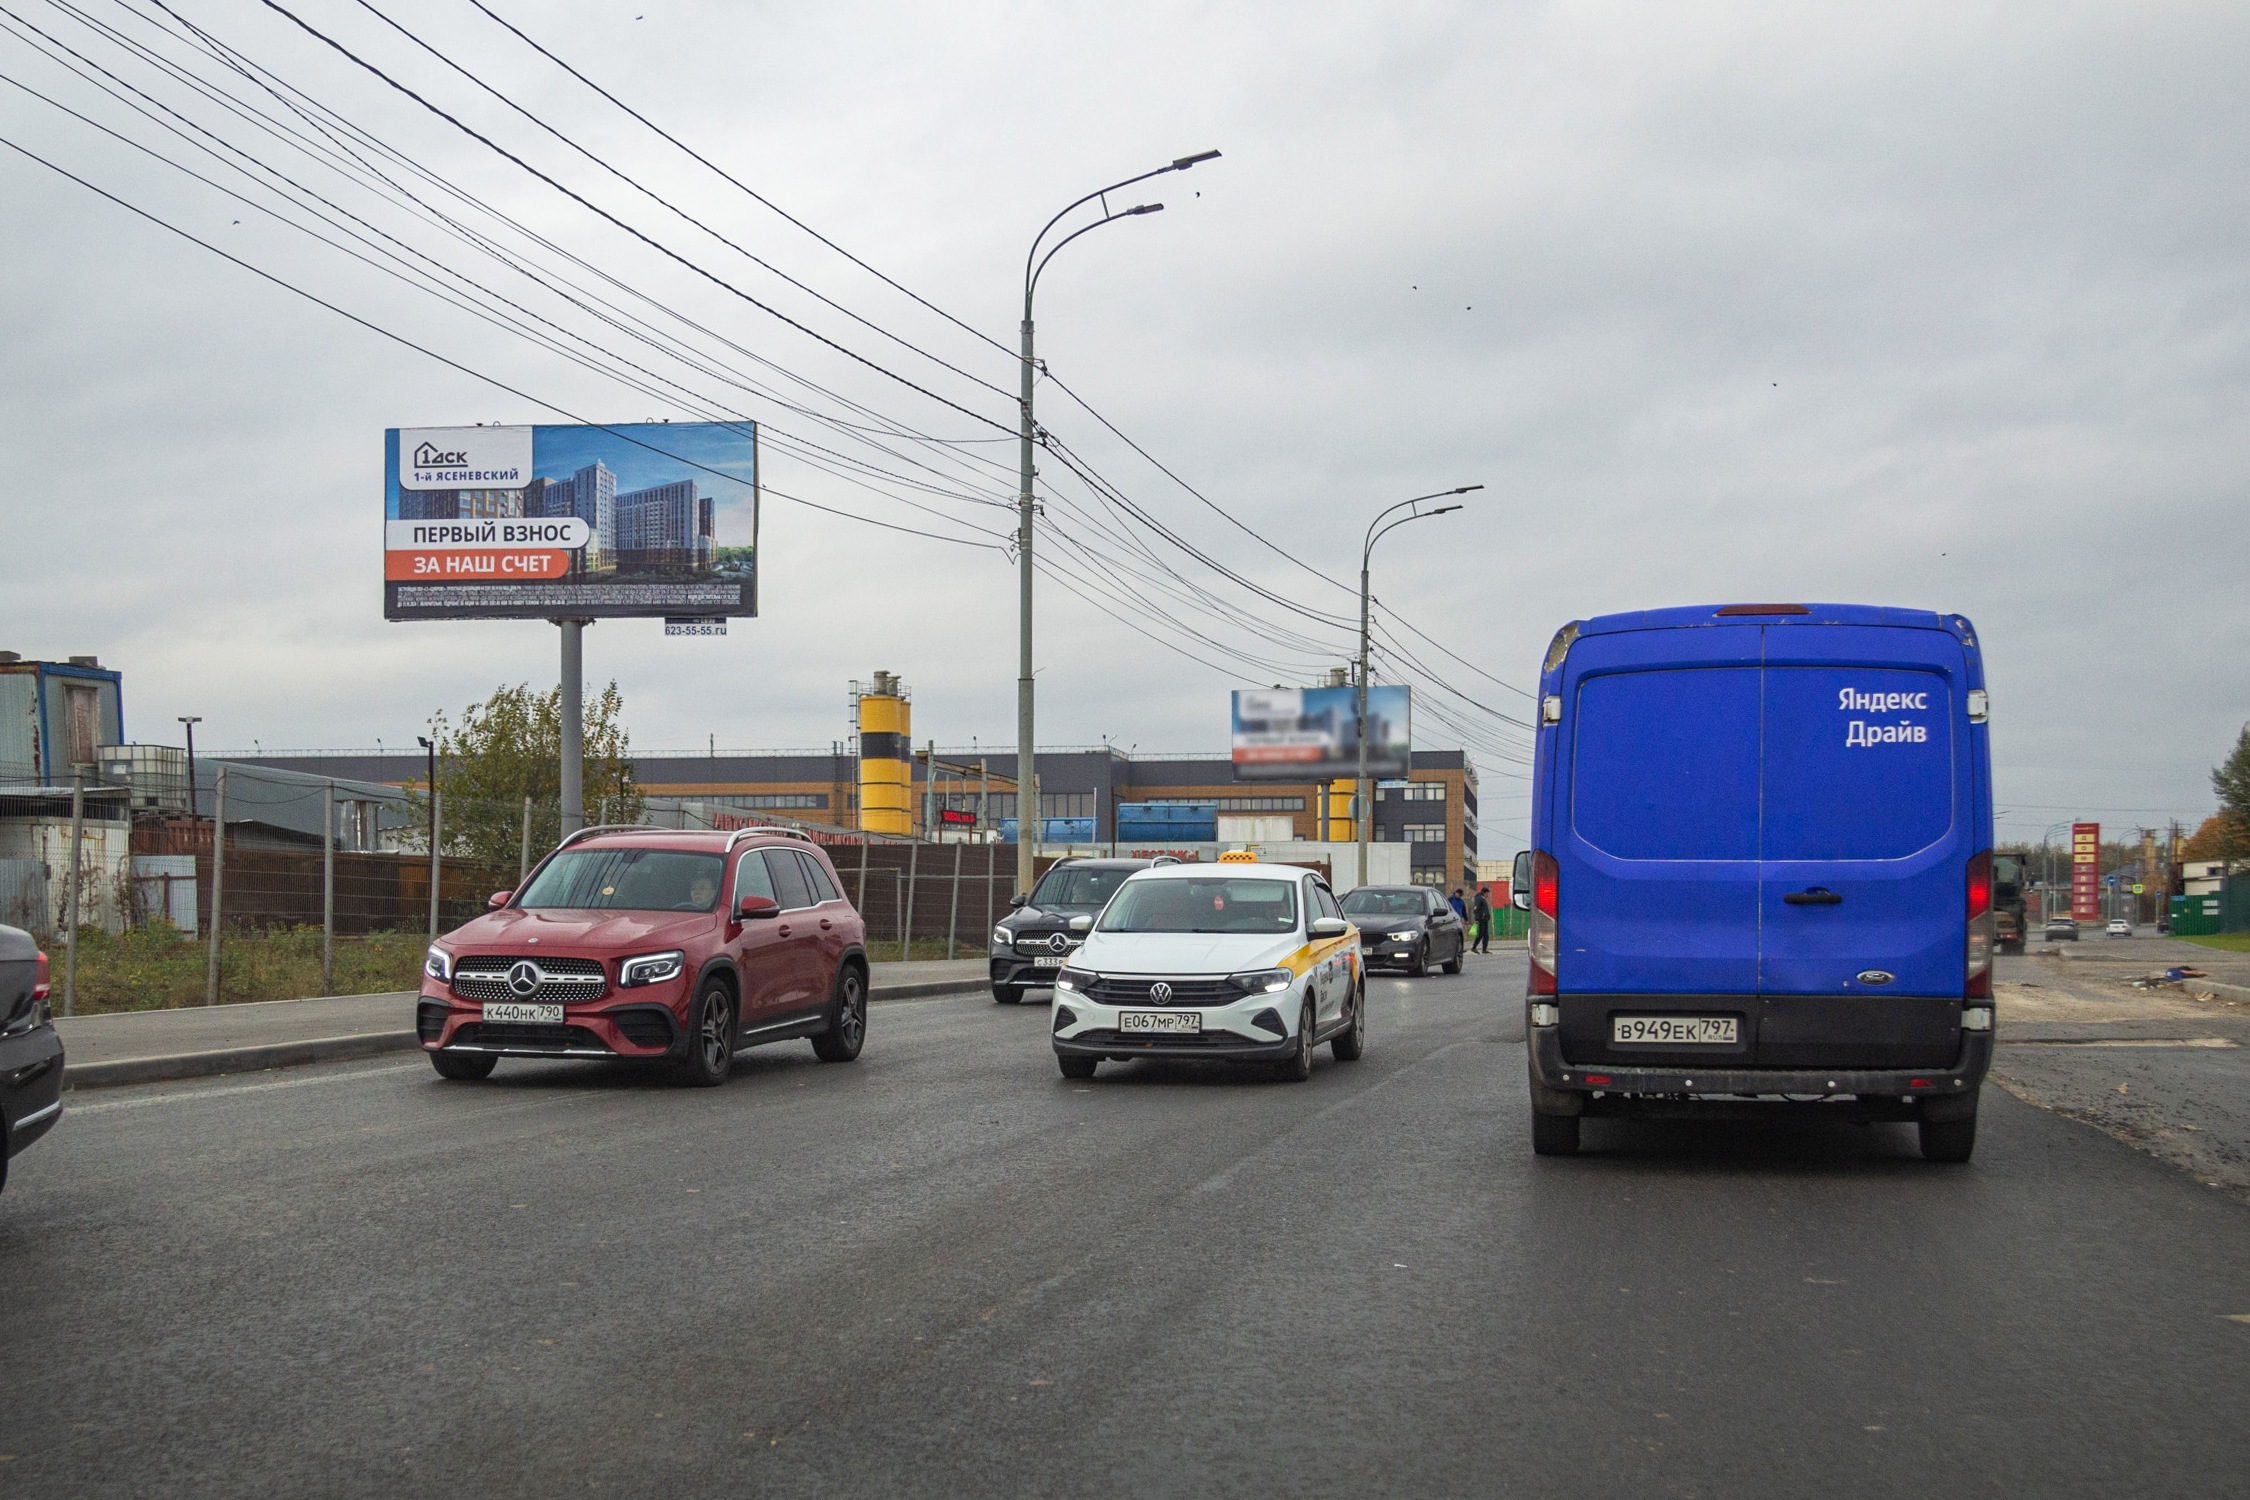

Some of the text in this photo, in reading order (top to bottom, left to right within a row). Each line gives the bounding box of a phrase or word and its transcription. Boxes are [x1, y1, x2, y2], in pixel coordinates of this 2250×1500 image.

[414, 468, 519, 482] 1-й ЯСЕНЕВСКИЙ
[413, 521, 571, 543] ПЕРВЫЙ ВЗНОС
[413, 554, 552, 573] ЗА НАШ СЧЕТ
[665, 626, 727, 636] 623-55-55.ru
[1838, 687, 1927, 713] Яндекс
[1845, 720, 1927, 748] Драйв
[487, 1005, 560, 1020] К440НК 790
[1124, 1014, 1196, 1028] Е067МР 797
[1621, 1020, 1731, 1040] В949ЕК 797
